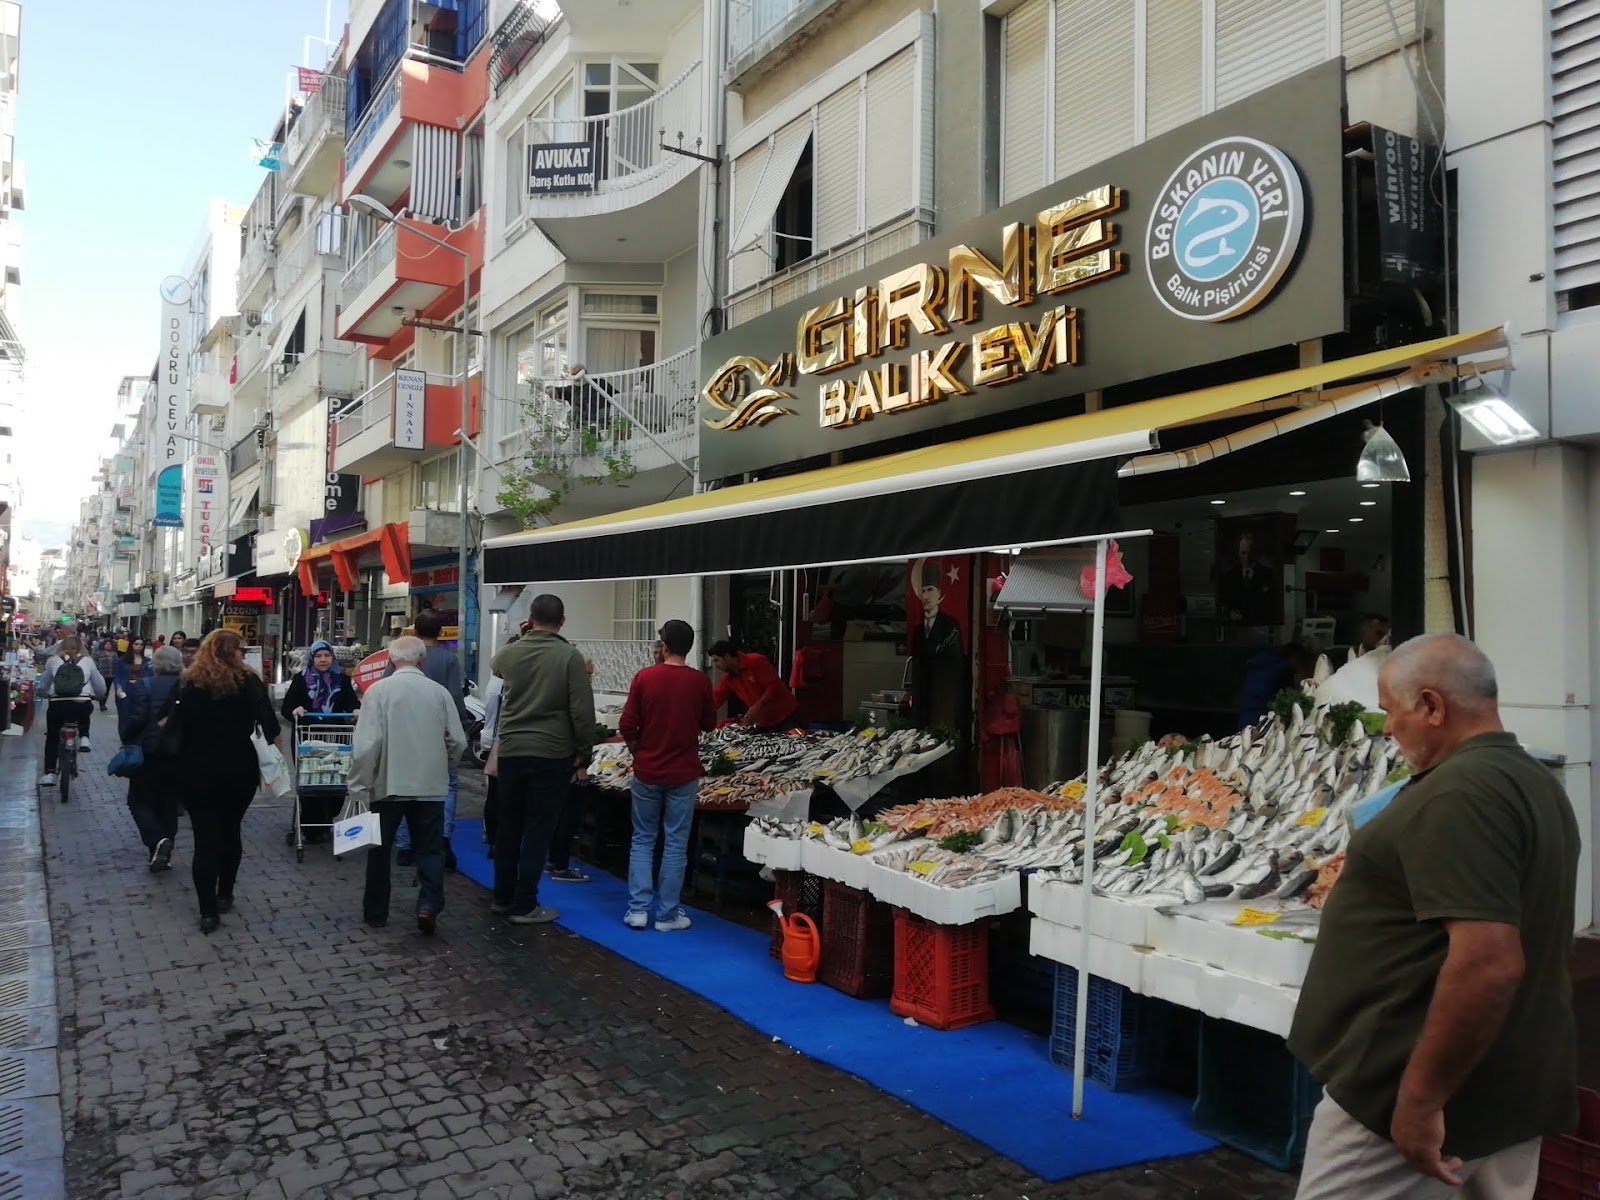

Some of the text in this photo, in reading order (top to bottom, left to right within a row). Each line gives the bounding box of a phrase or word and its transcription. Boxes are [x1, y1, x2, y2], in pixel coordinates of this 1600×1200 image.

[530, 175, 552, 190] Barış
[553, 174, 576, 187] Kutlu
[535, 148, 590, 169] AVUKAT
[1152, 150, 1289, 260] BAŞKANIN YERİ
[797, 184, 1121, 375] GİRNE
[1166, 244, 1272, 309] Balık Pişiricisi
[166, 317, 180, 460] DOĞRU CEVAP
[398, 374, 423, 383] KENAN
[819, 304, 1080, 428] BALIK EVİ
[405, 392, 414, 443] İNŞAAT
[197, 456, 216, 466] OKUL
